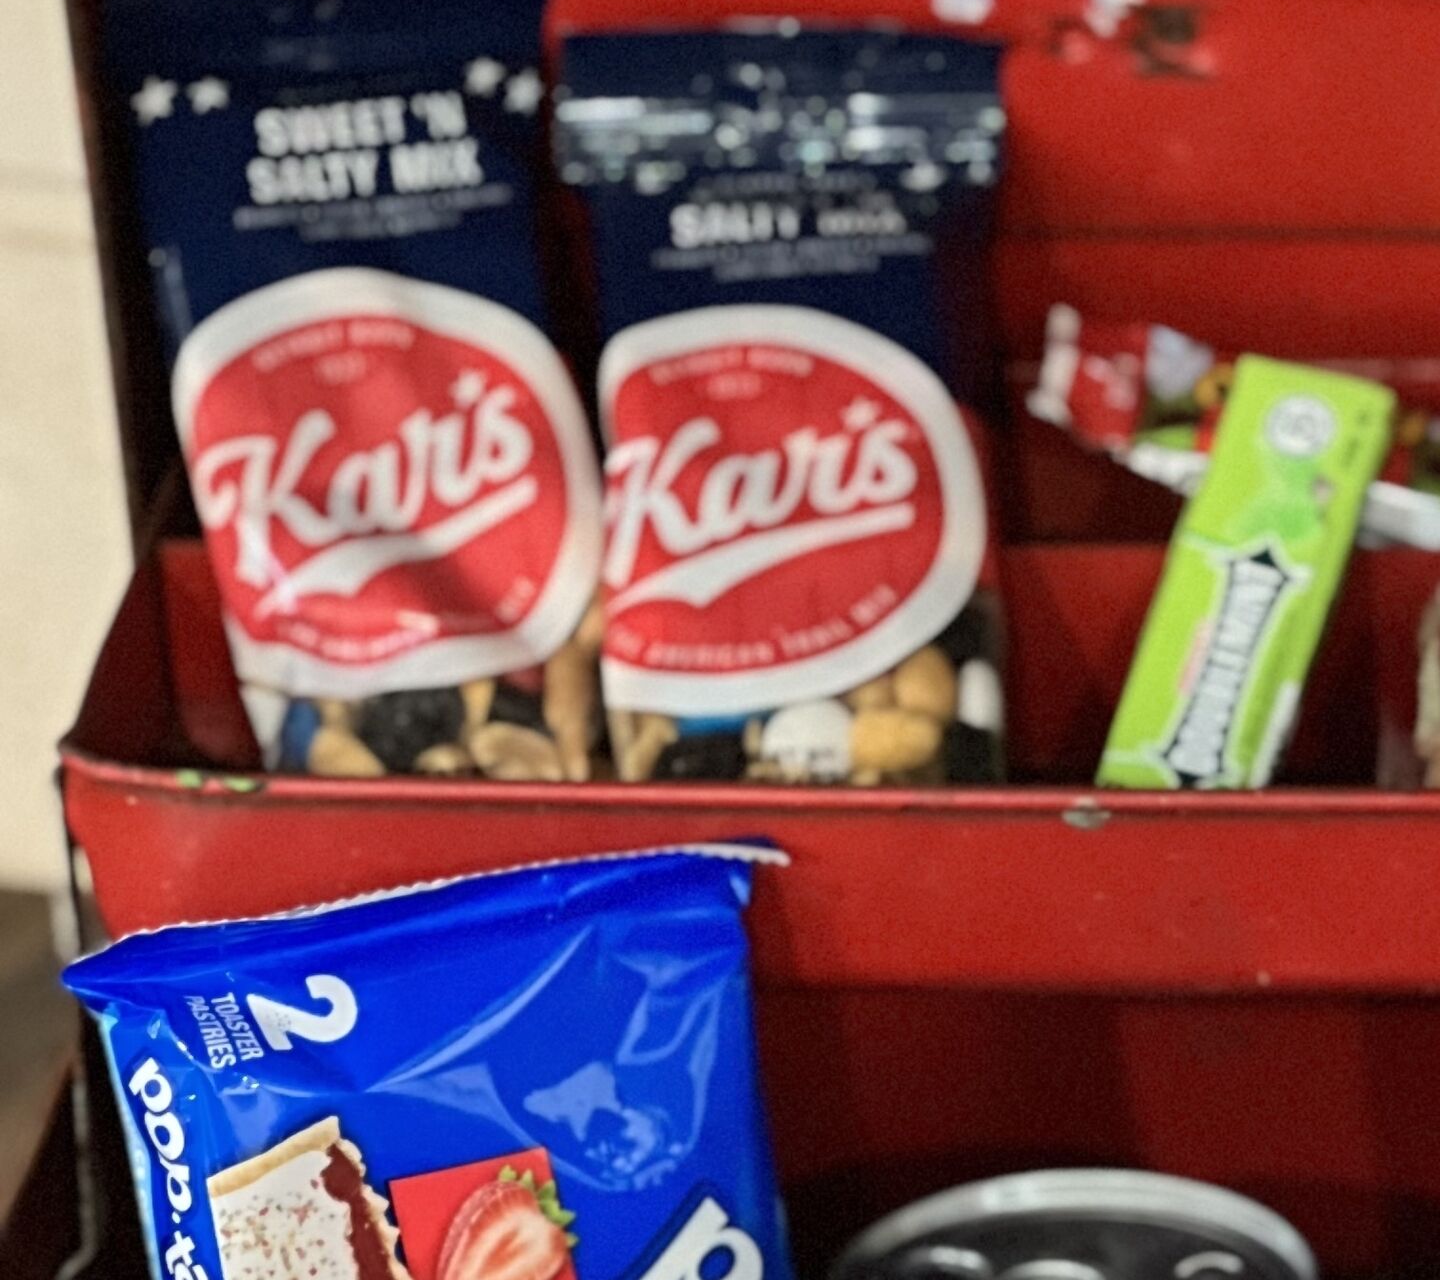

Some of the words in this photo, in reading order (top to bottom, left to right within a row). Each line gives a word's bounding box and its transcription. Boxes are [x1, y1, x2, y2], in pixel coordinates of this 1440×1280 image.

[184, 995, 237, 1069] PASTRIES
[211, 992, 265, 1062] TOASTER
[246, 974, 358, 1051] 2
